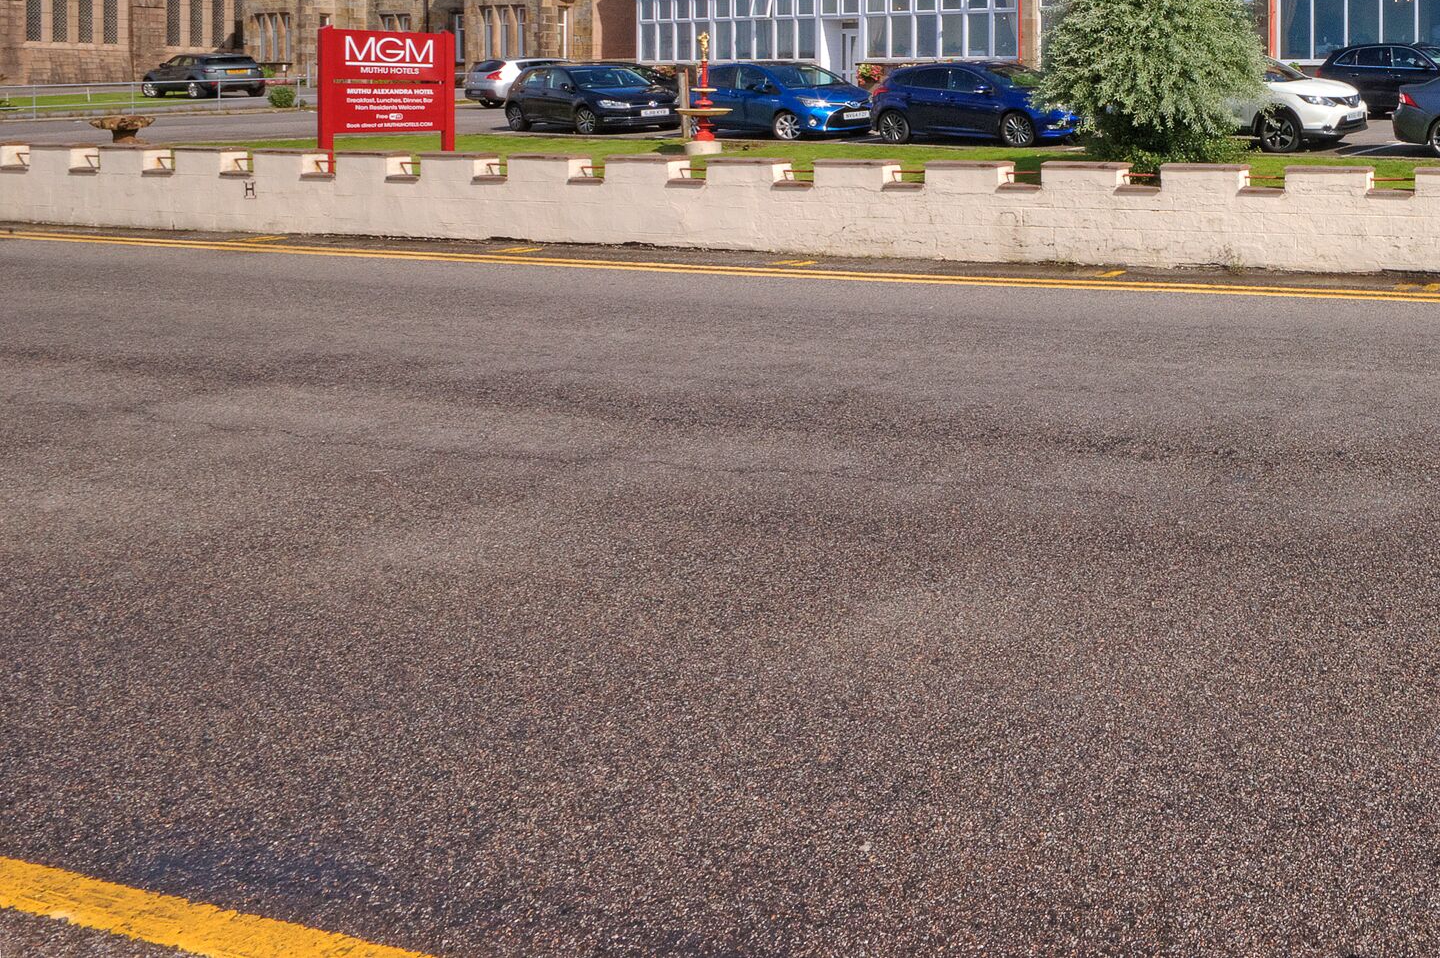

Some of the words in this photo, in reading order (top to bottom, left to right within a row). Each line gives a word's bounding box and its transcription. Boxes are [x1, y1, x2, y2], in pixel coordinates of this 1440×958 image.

[345, 35, 434, 63] MGM
[360, 66, 388, 74] MUTHU
[389, 67, 420, 75] HOTELS
